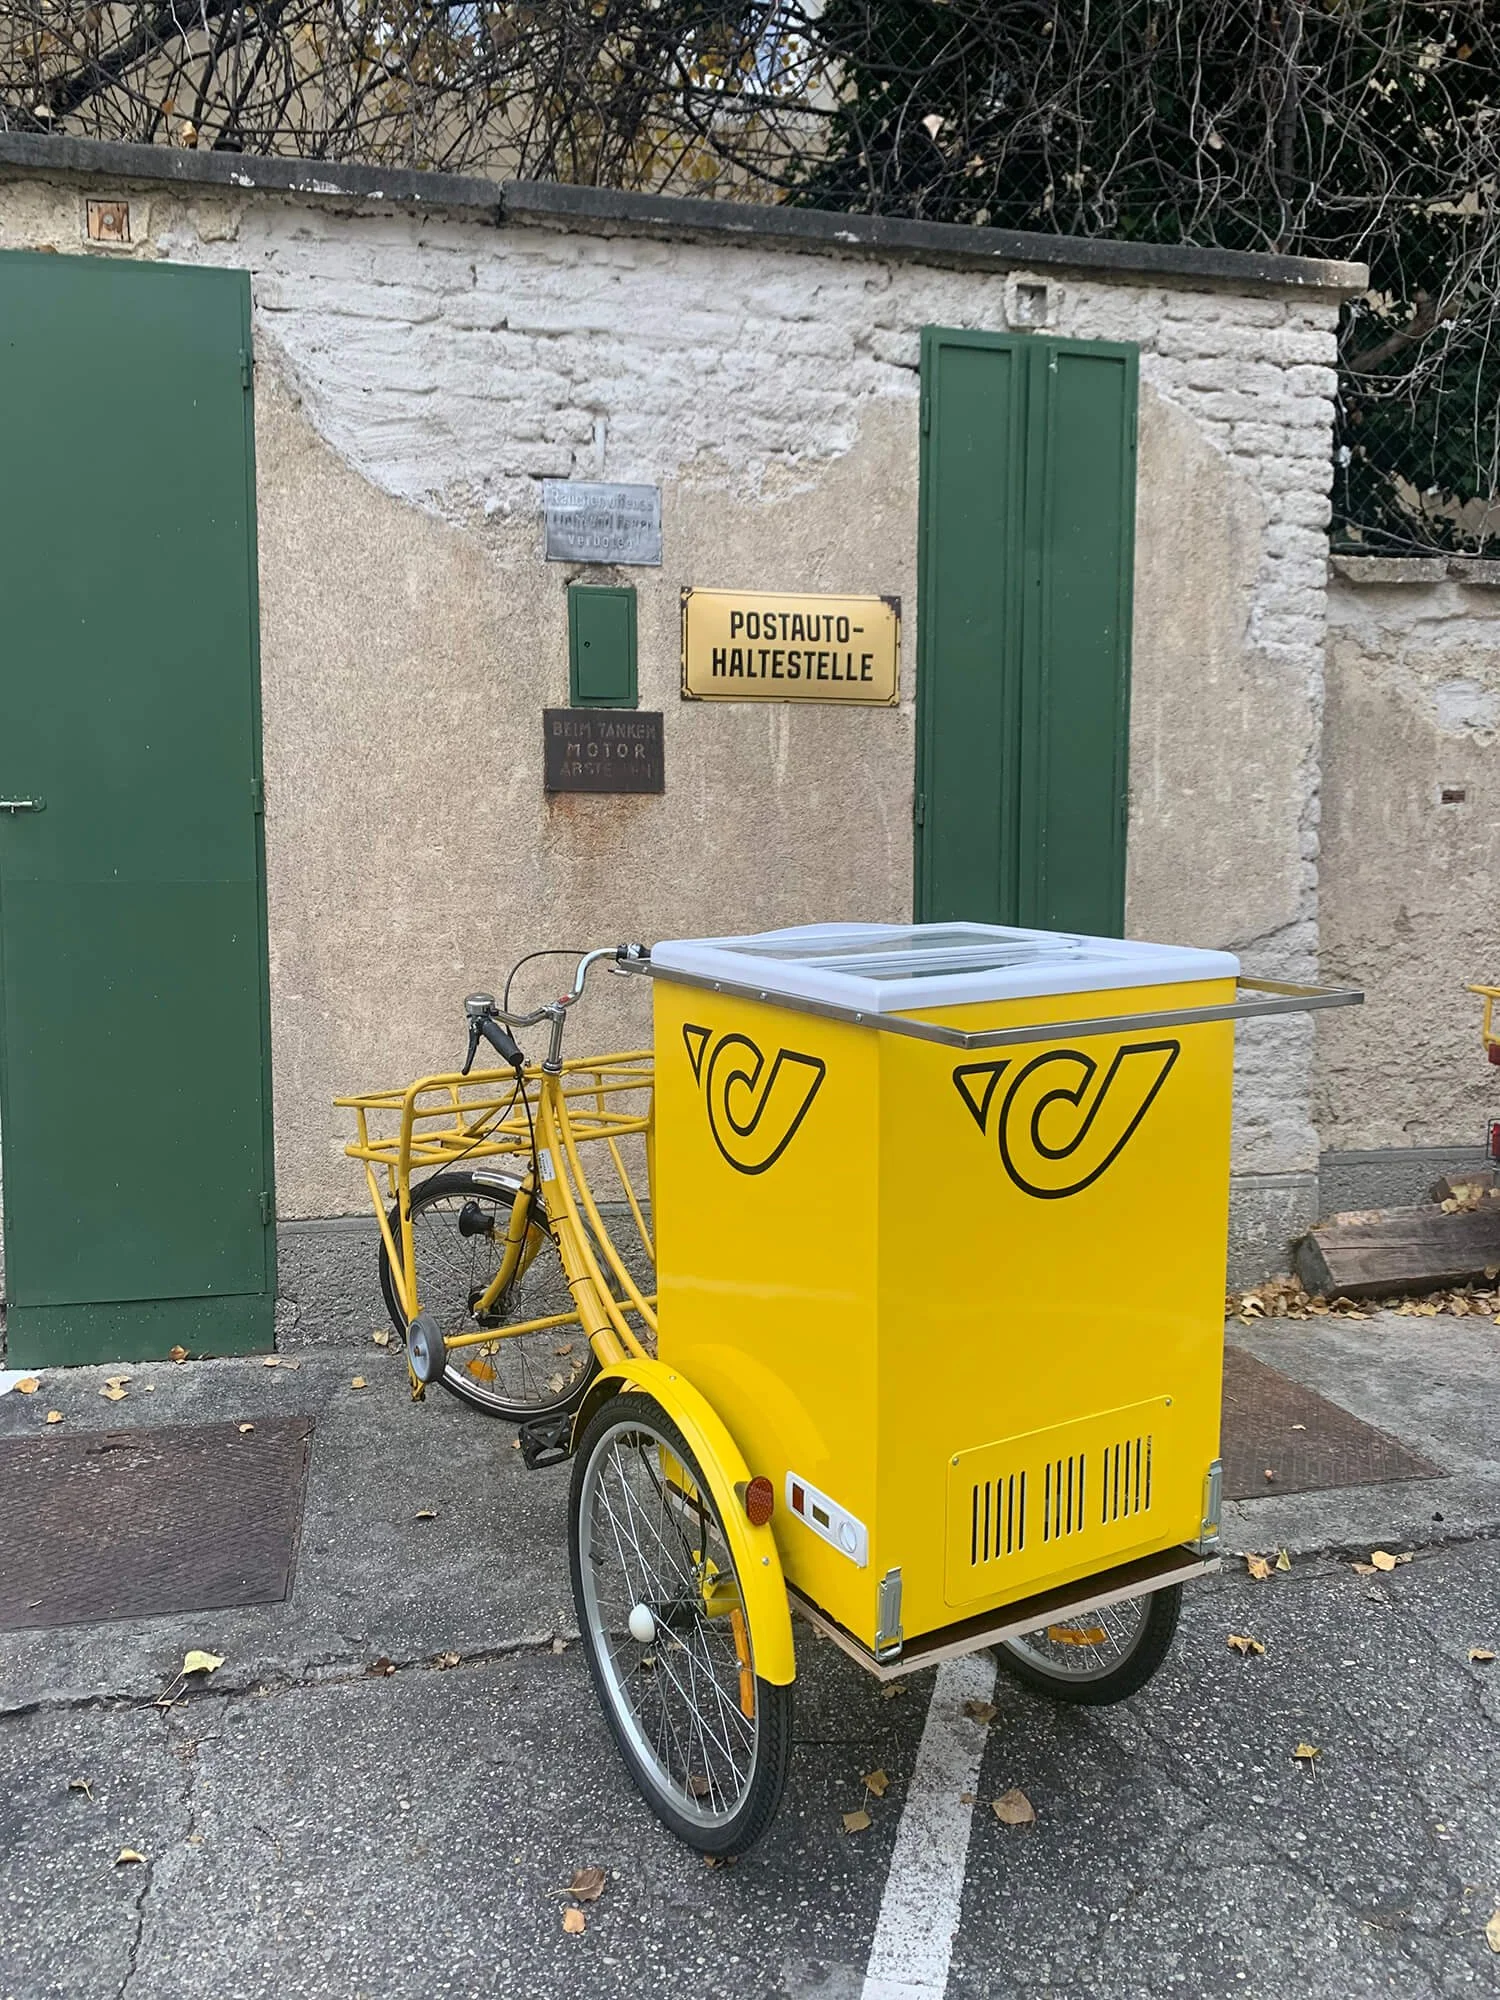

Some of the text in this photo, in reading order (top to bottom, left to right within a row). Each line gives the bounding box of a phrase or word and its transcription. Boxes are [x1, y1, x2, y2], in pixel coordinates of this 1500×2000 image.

[730, 610, 865, 644] POSTAUTO-
[712, 647, 874, 682] HALTESTELLE
[552, 720, 657, 740] BEIM TANKEN
[566, 742, 647, 760] MOTOR
